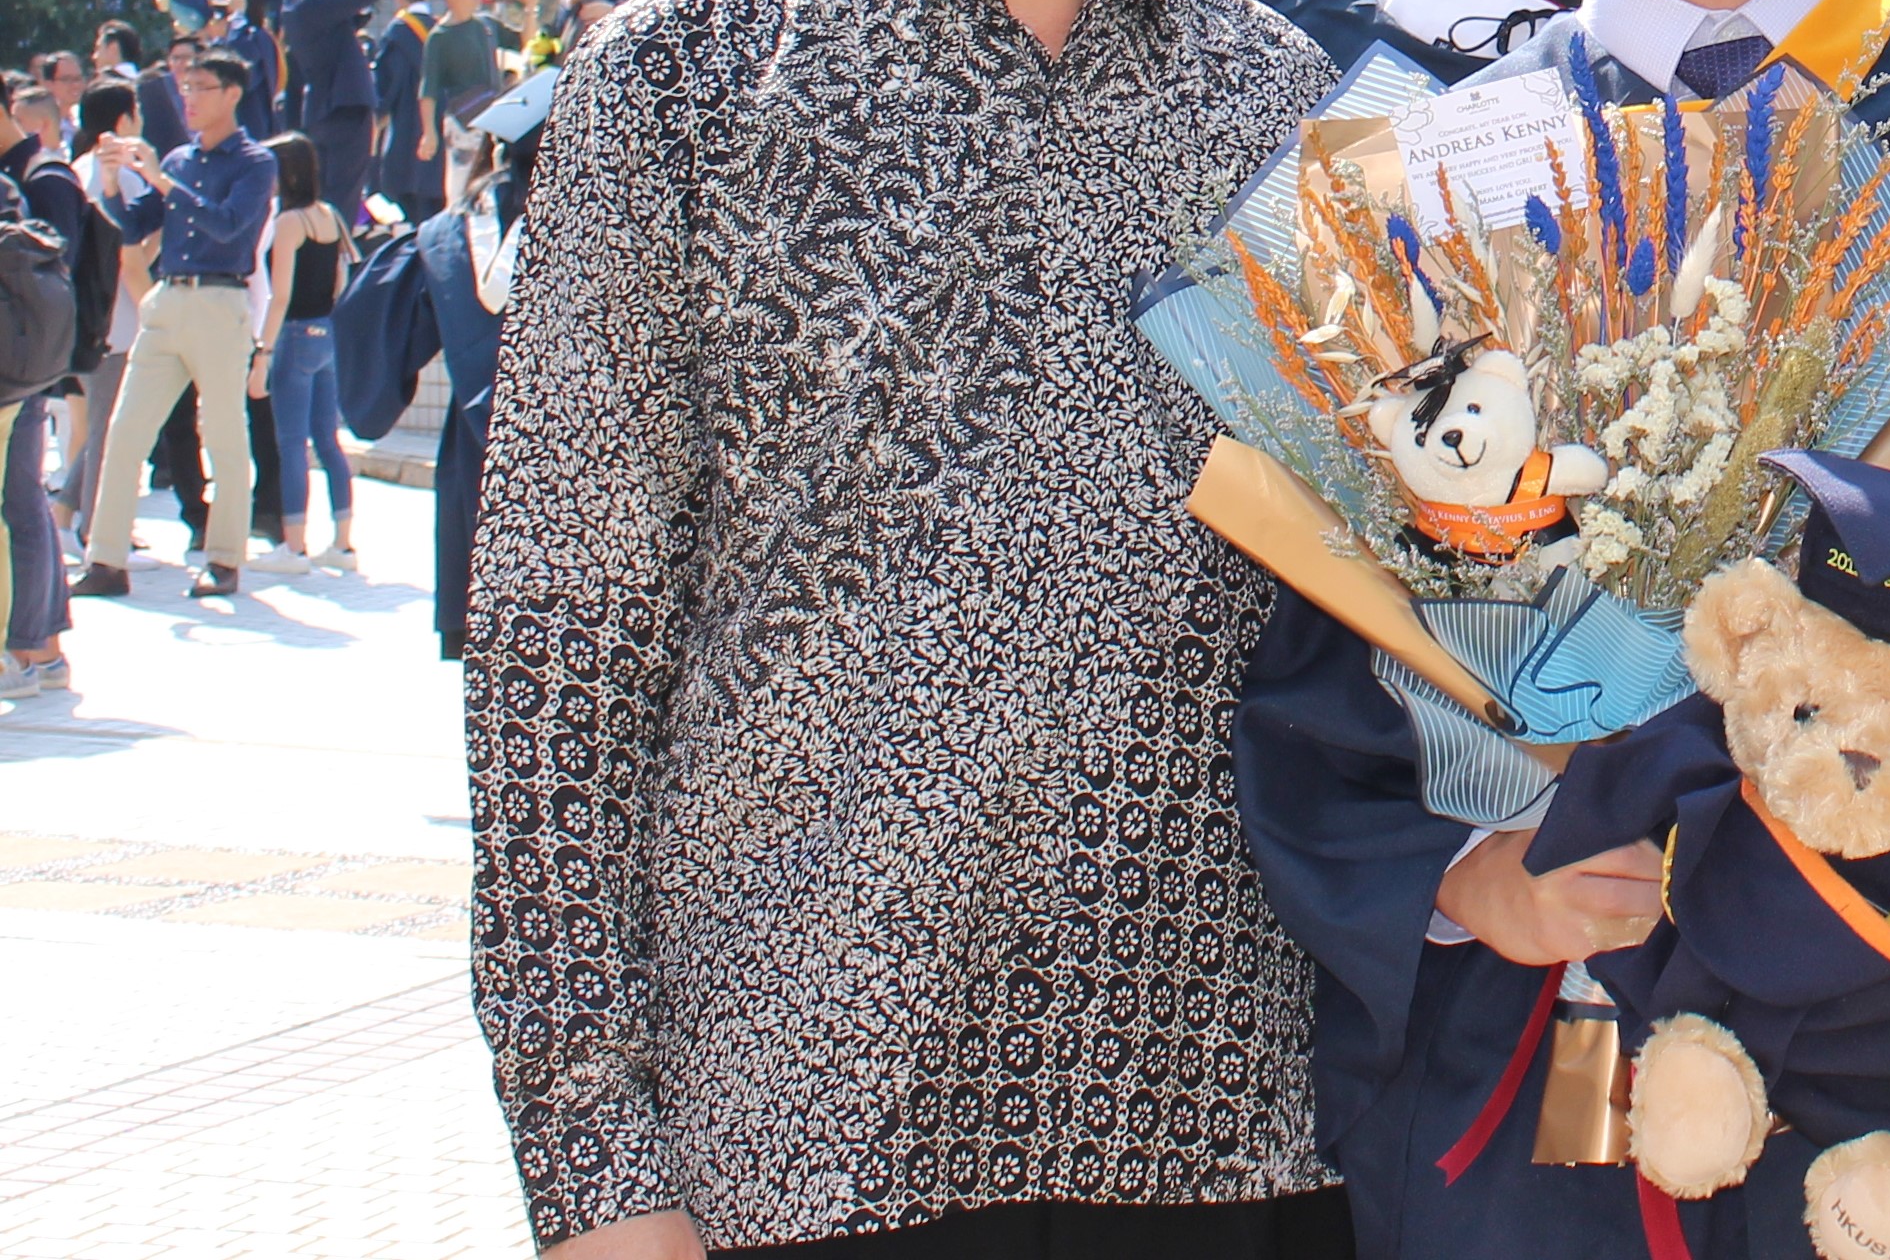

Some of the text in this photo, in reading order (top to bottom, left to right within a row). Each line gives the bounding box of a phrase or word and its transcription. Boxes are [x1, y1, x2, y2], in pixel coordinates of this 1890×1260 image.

[1456, 97, 1500, 113] CHARLOTTE
[1407, 114, 1568, 166] ANDREAS KENNY
[1519, 143, 1544, 155] PROUD
[1479, 194, 1504, 206] MAMA
[1437, 510, 1470, 525] KENNY
[1472, 513, 1526, 525] OTAVIUS,
[1826, 547, 1859, 577] 201
